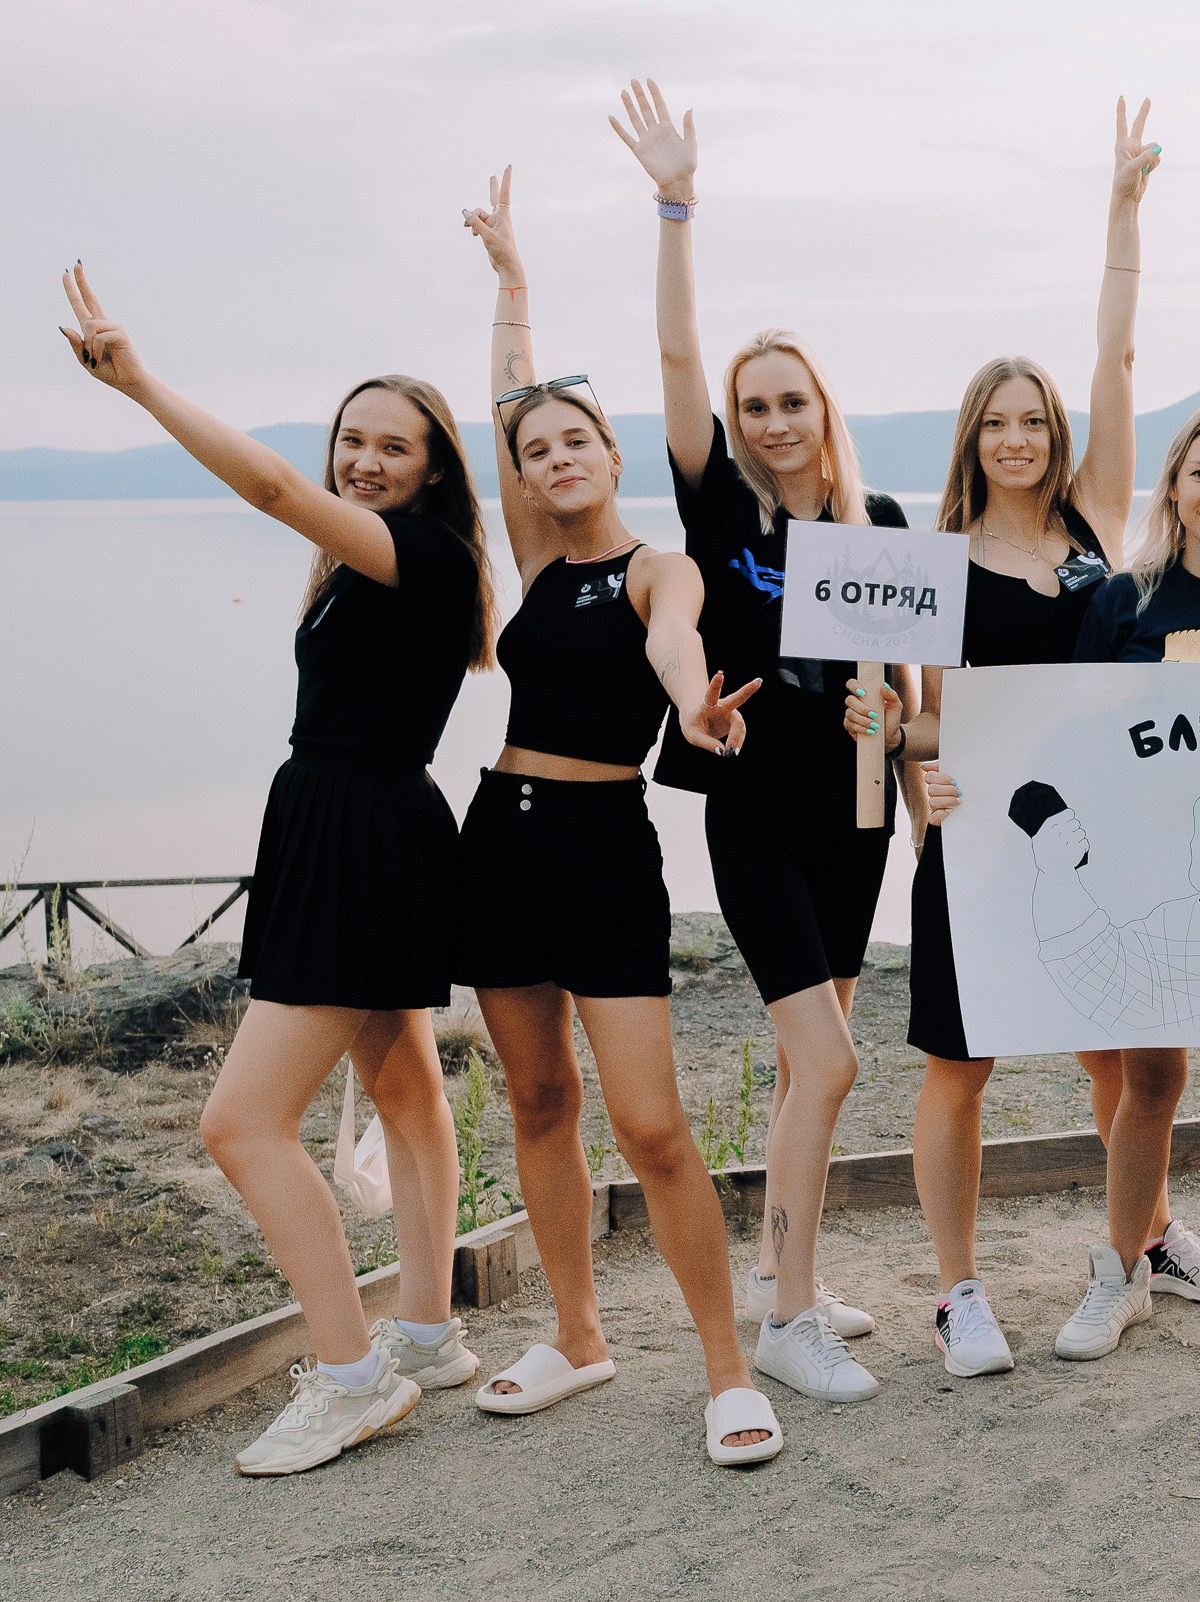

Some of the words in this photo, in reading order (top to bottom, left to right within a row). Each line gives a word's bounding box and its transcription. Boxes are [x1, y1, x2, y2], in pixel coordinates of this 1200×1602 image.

[814, 579, 832, 602] 6
[840, 581, 938, 617] ОТРЯД
[832, 624, 880, 648] СМЕНА
